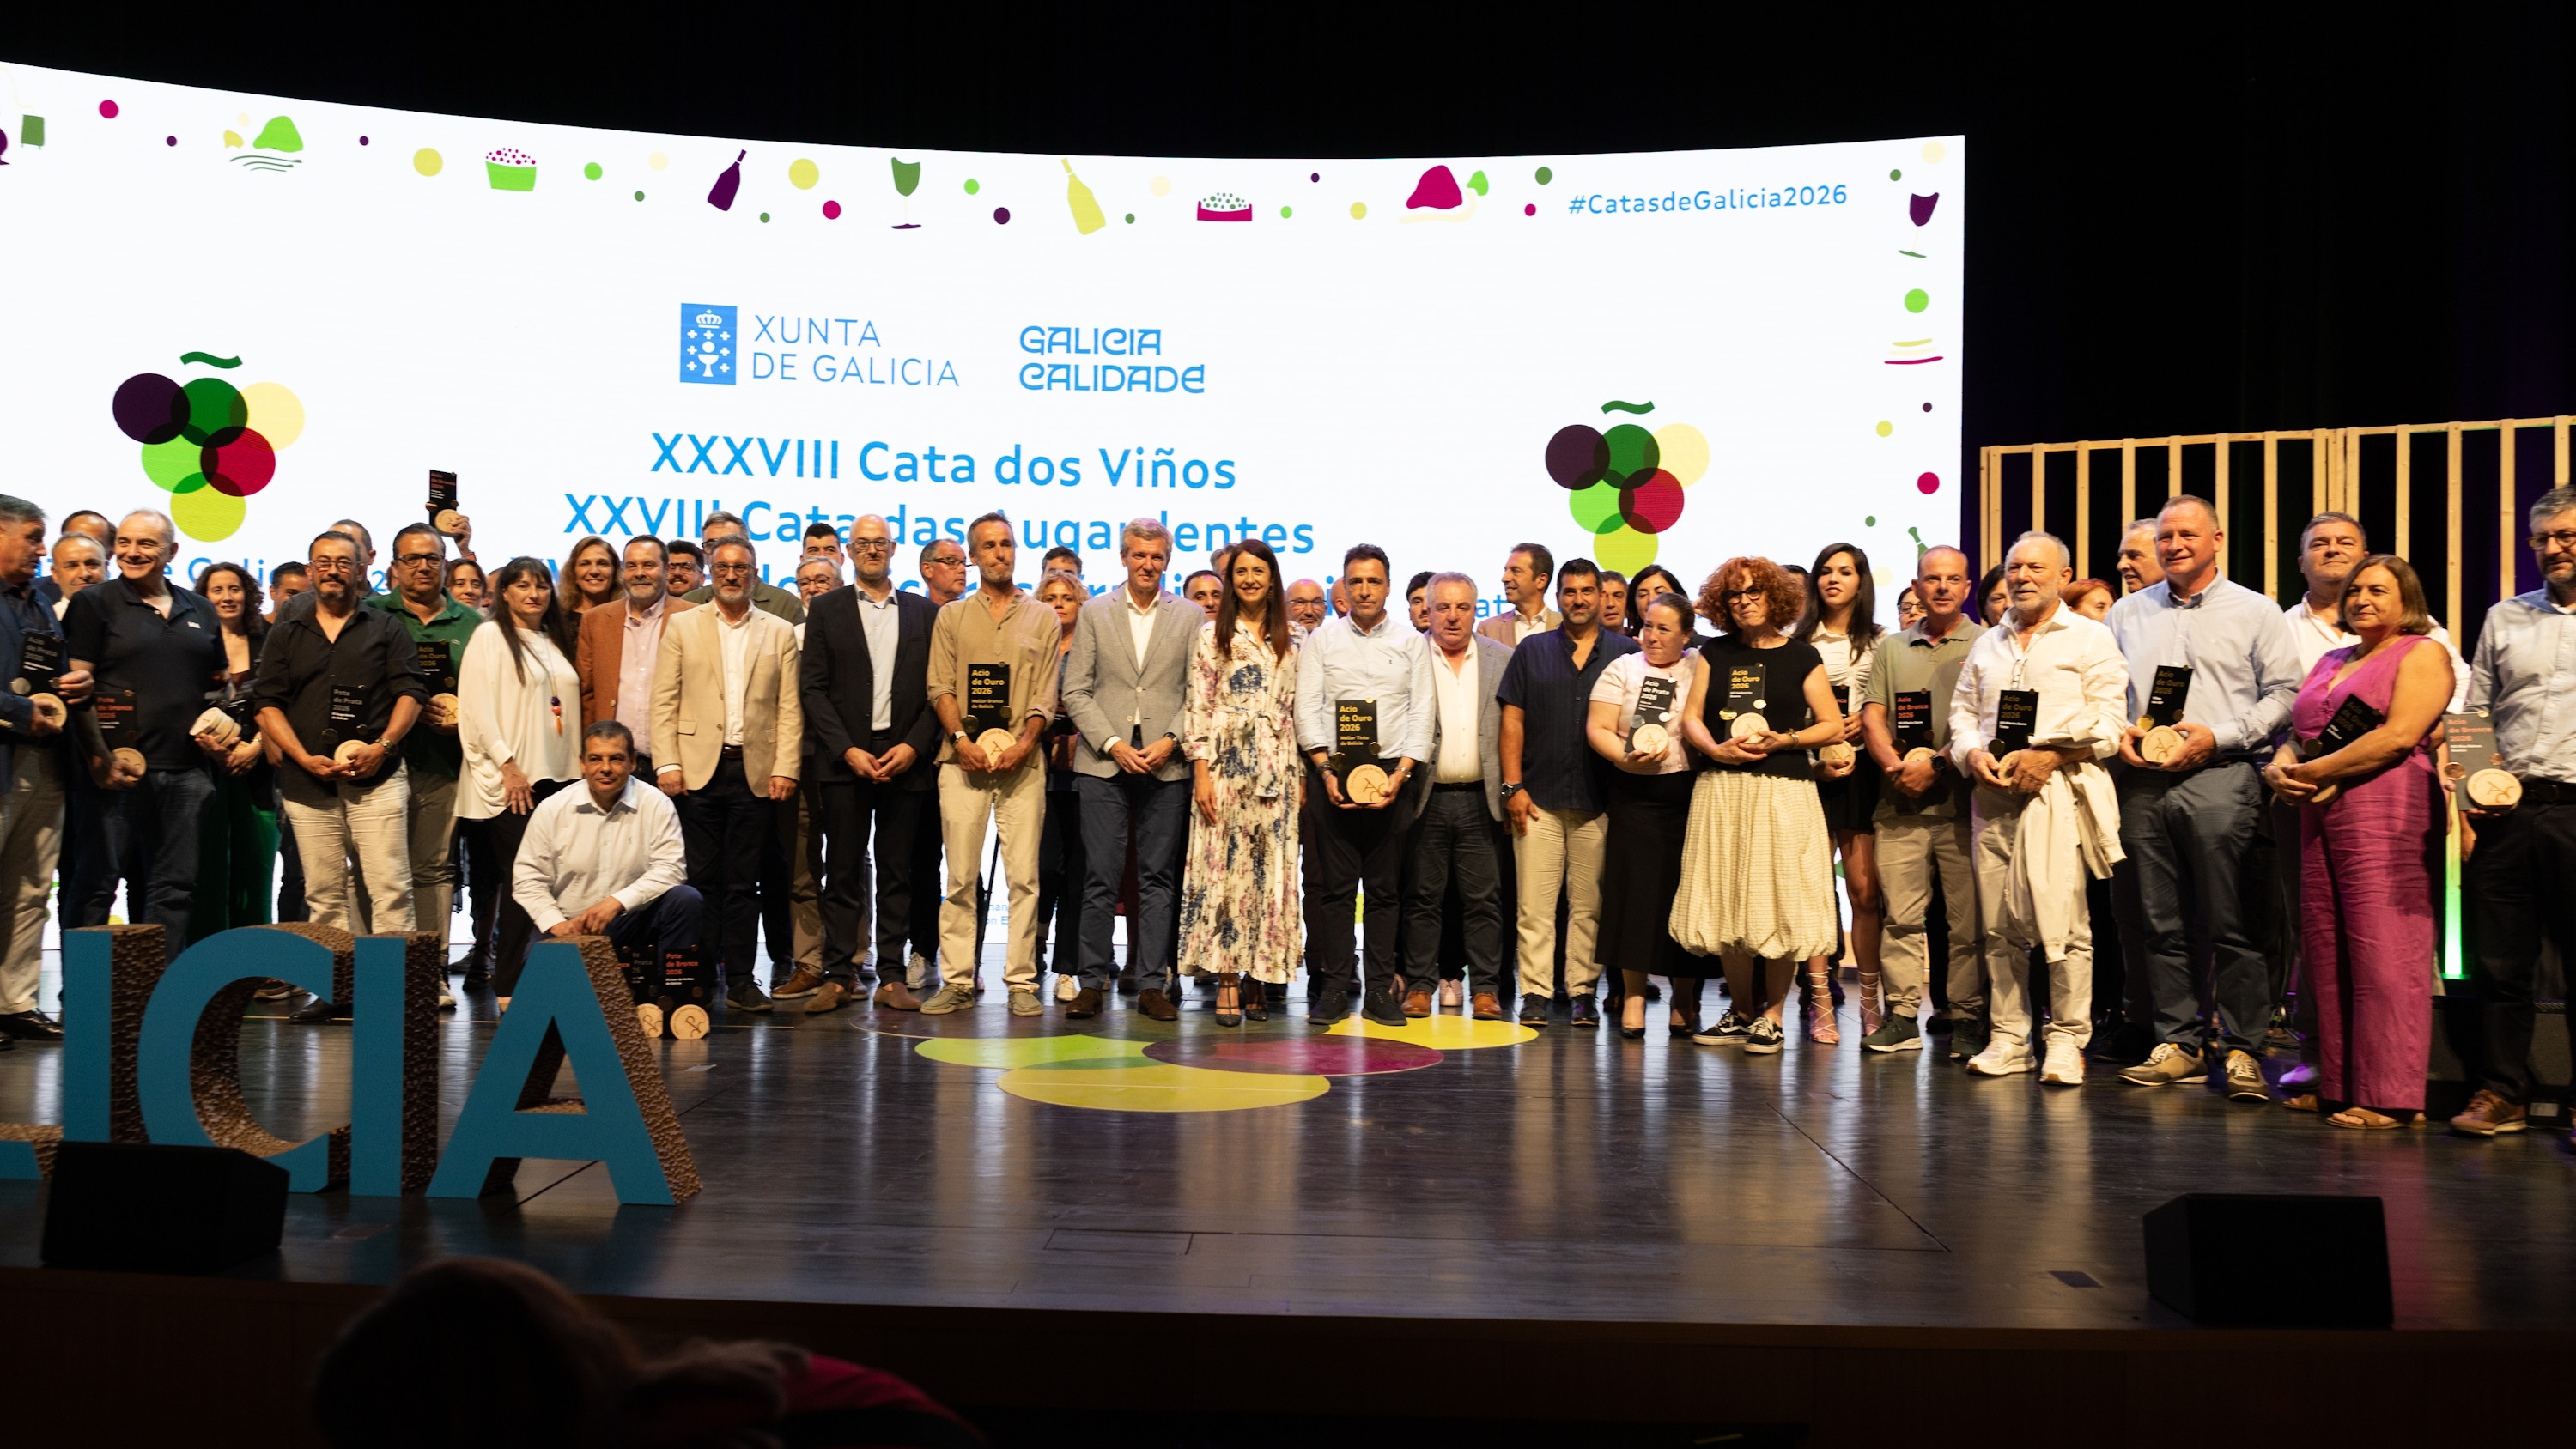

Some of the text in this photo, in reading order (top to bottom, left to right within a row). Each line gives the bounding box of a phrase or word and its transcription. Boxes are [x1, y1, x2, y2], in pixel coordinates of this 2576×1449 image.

[1569, 185, 1847, 215] #CatasdeGalicia2026
[755, 315, 881, 348] XUNTA
[1019, 325, 1162, 356] GALICIA
[753, 352, 960, 388] DE GALICIA
[1019, 363, 1206, 394] CALIDADE
[651, 433, 1236, 489] XXXVIII Cata dos Viños
[971, 687, 993, 695] 2026
[1339, 705, 1358, 713] Acio
